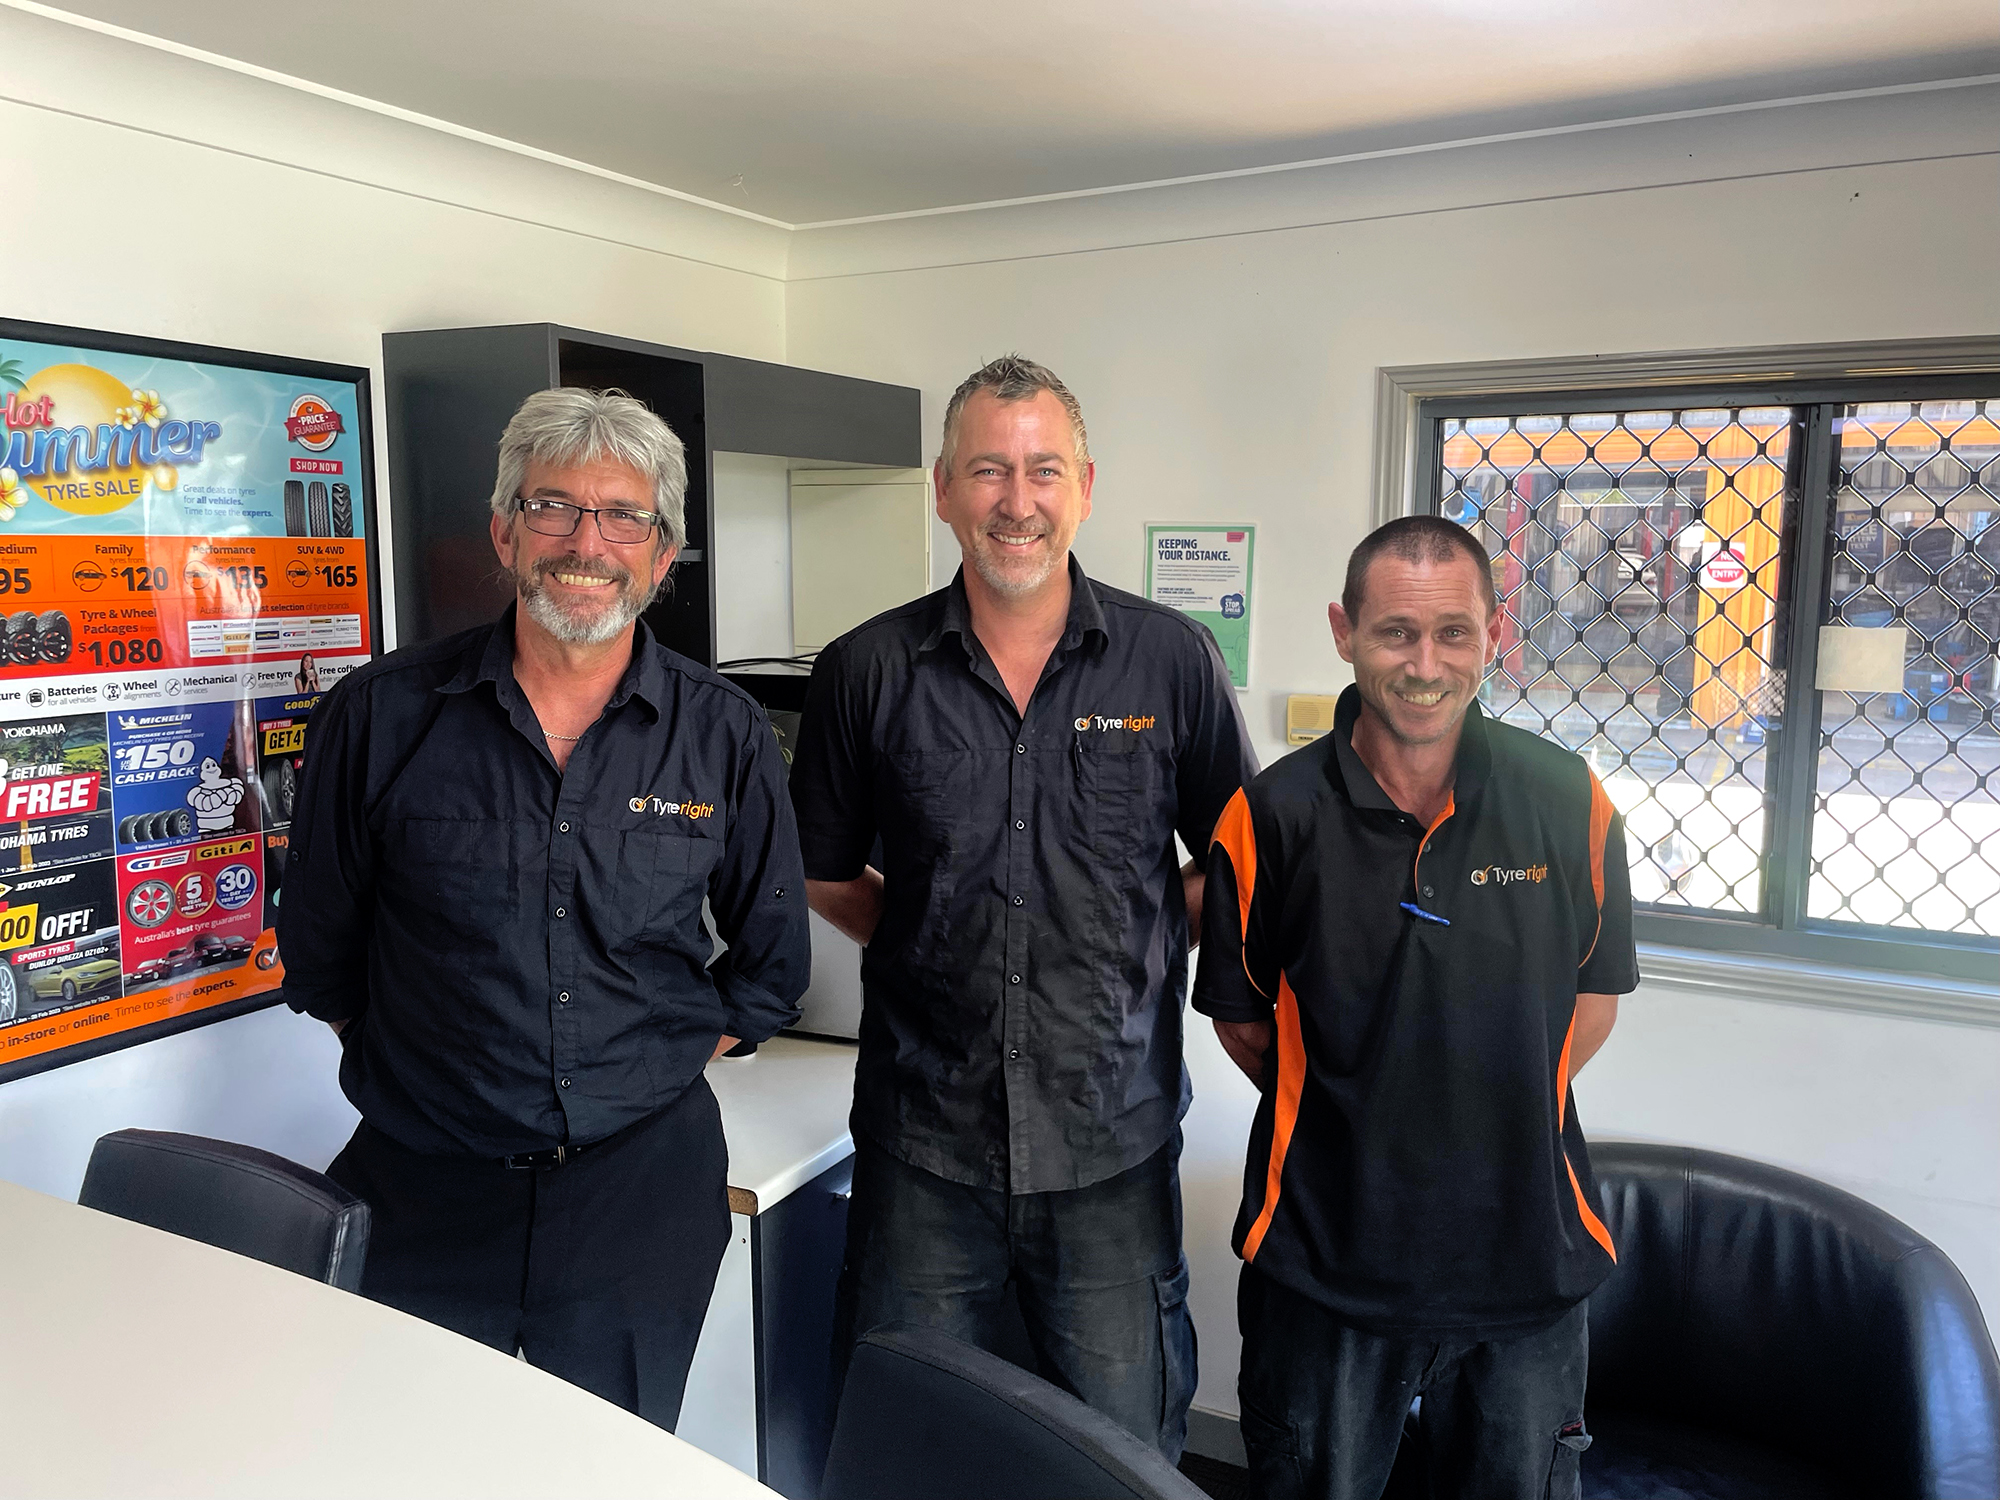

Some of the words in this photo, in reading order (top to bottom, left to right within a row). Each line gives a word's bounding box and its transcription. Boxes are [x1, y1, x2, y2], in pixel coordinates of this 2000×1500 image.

[300, 414, 325, 426] PRICE
[294, 421, 336, 436] GUARANTEE
[0, 420, 222, 478] ummer
[296, 460, 317, 470] SHOP
[320, 463, 338, 472] NOW
[44, 482, 90, 501] TYRE
[95, 478, 140, 497] SALE
[183, 484, 205, 493] Great
[206, 486, 226, 494] deals
[238, 488, 256, 497] tyres
[184, 496, 195, 504] for
[196, 496, 206, 504] all
[208, 497, 244, 506] vehicles.
[184, 506, 203, 516] Time
[204, 508, 212, 516] to
[228, 508, 240, 516] the
[242, 510, 274, 518] experts.
[95, 544, 133, 556] Family
[192, 544, 256, 554] Performance
[297, 546, 314, 554] SUV
[316, 546, 323, 554] &
[325, 546, 345, 554] 4WD
[1158, 539, 1197, 549] KEEPING
[1158, 550, 1183, 560] YOUR
[1186, 550, 1230, 561] DISTANCE.
[111, 567, 168, 592] $120
[217, 566, 268, 590] $135
[314, 566, 358, 587] $165
[1712, 570, 1739, 578] ENTRY
[80, 610, 106, 622] Tyre
[109, 609, 118, 619] &
[121, 608, 157, 618] Wheel
[240, 604, 269, 614] largst
[270, 602, 304, 611] selection
[314, 603, 326, 612] tyre
[327, 602, 349, 610] brands
[84, 624, 138, 636] Packages
[78, 638, 163, 667] $1,080
[258, 672, 275, 680] Free
[276, 670, 293, 680] tyre
[319, 666, 336, 675] Free
[338, 664, 360, 673] coffe
[123, 680, 157, 691] Wheel
[183, 674, 237, 686] Mechanical
[48, 684, 97, 697] Batteries
[124, 691, 162, 701] alignments
[184, 687, 208, 695] services
[69, 696, 96, 704] vehicles
[139, 713, 192, 724] MICHELIN
[1095, 714, 1155, 732] Tyreright
[2, 723, 66, 738] YOKOHAMA
[270, 730, 293, 750] GET
[293, 730, 300, 745] 4
[115, 740, 195, 770] $150
[12, 766, 37, 780] GET
[38, 763, 64, 777] ONE
[115, 772, 156, 784] CASH
[158, 767, 195, 779] BACK
[6, 777, 92, 818] FREE
[653, 798, 714, 819] Tyreright
[0, 832, 46, 850] OHAMA
[50, 825, 89, 842] TYRES
[268, 835, 289, 848] Buy
[200, 845, 233, 858] Giti
[15, 873, 76, 891] DUNLOP
[220, 868, 251, 892] 30
[186, 876, 202, 899] 5
[41, 908, 90, 940] OFF!
[134, 929, 175, 944] Australia's
[176, 924, 194, 935] best
[195, 921, 210, 932] tyre
[211, 912, 251, 928] guarantees
[17, 950, 46, 962] SPORTS
[48, 944, 71, 955] TYRES
[29, 958, 56, 970] DUNLOP
[57, 952, 84, 964] DIREZZA
[8, 1028, 56, 1047] in-store
[58, 1024, 70, 1033] or
[73, 1013, 113, 1028] online.
[115, 1004, 141, 1017] Time
[143, 1001, 154, 1010] to
[156, 998, 174, 1007] see
[175, 991, 191, 1001] the
[192, 979, 237, 996] experts.
